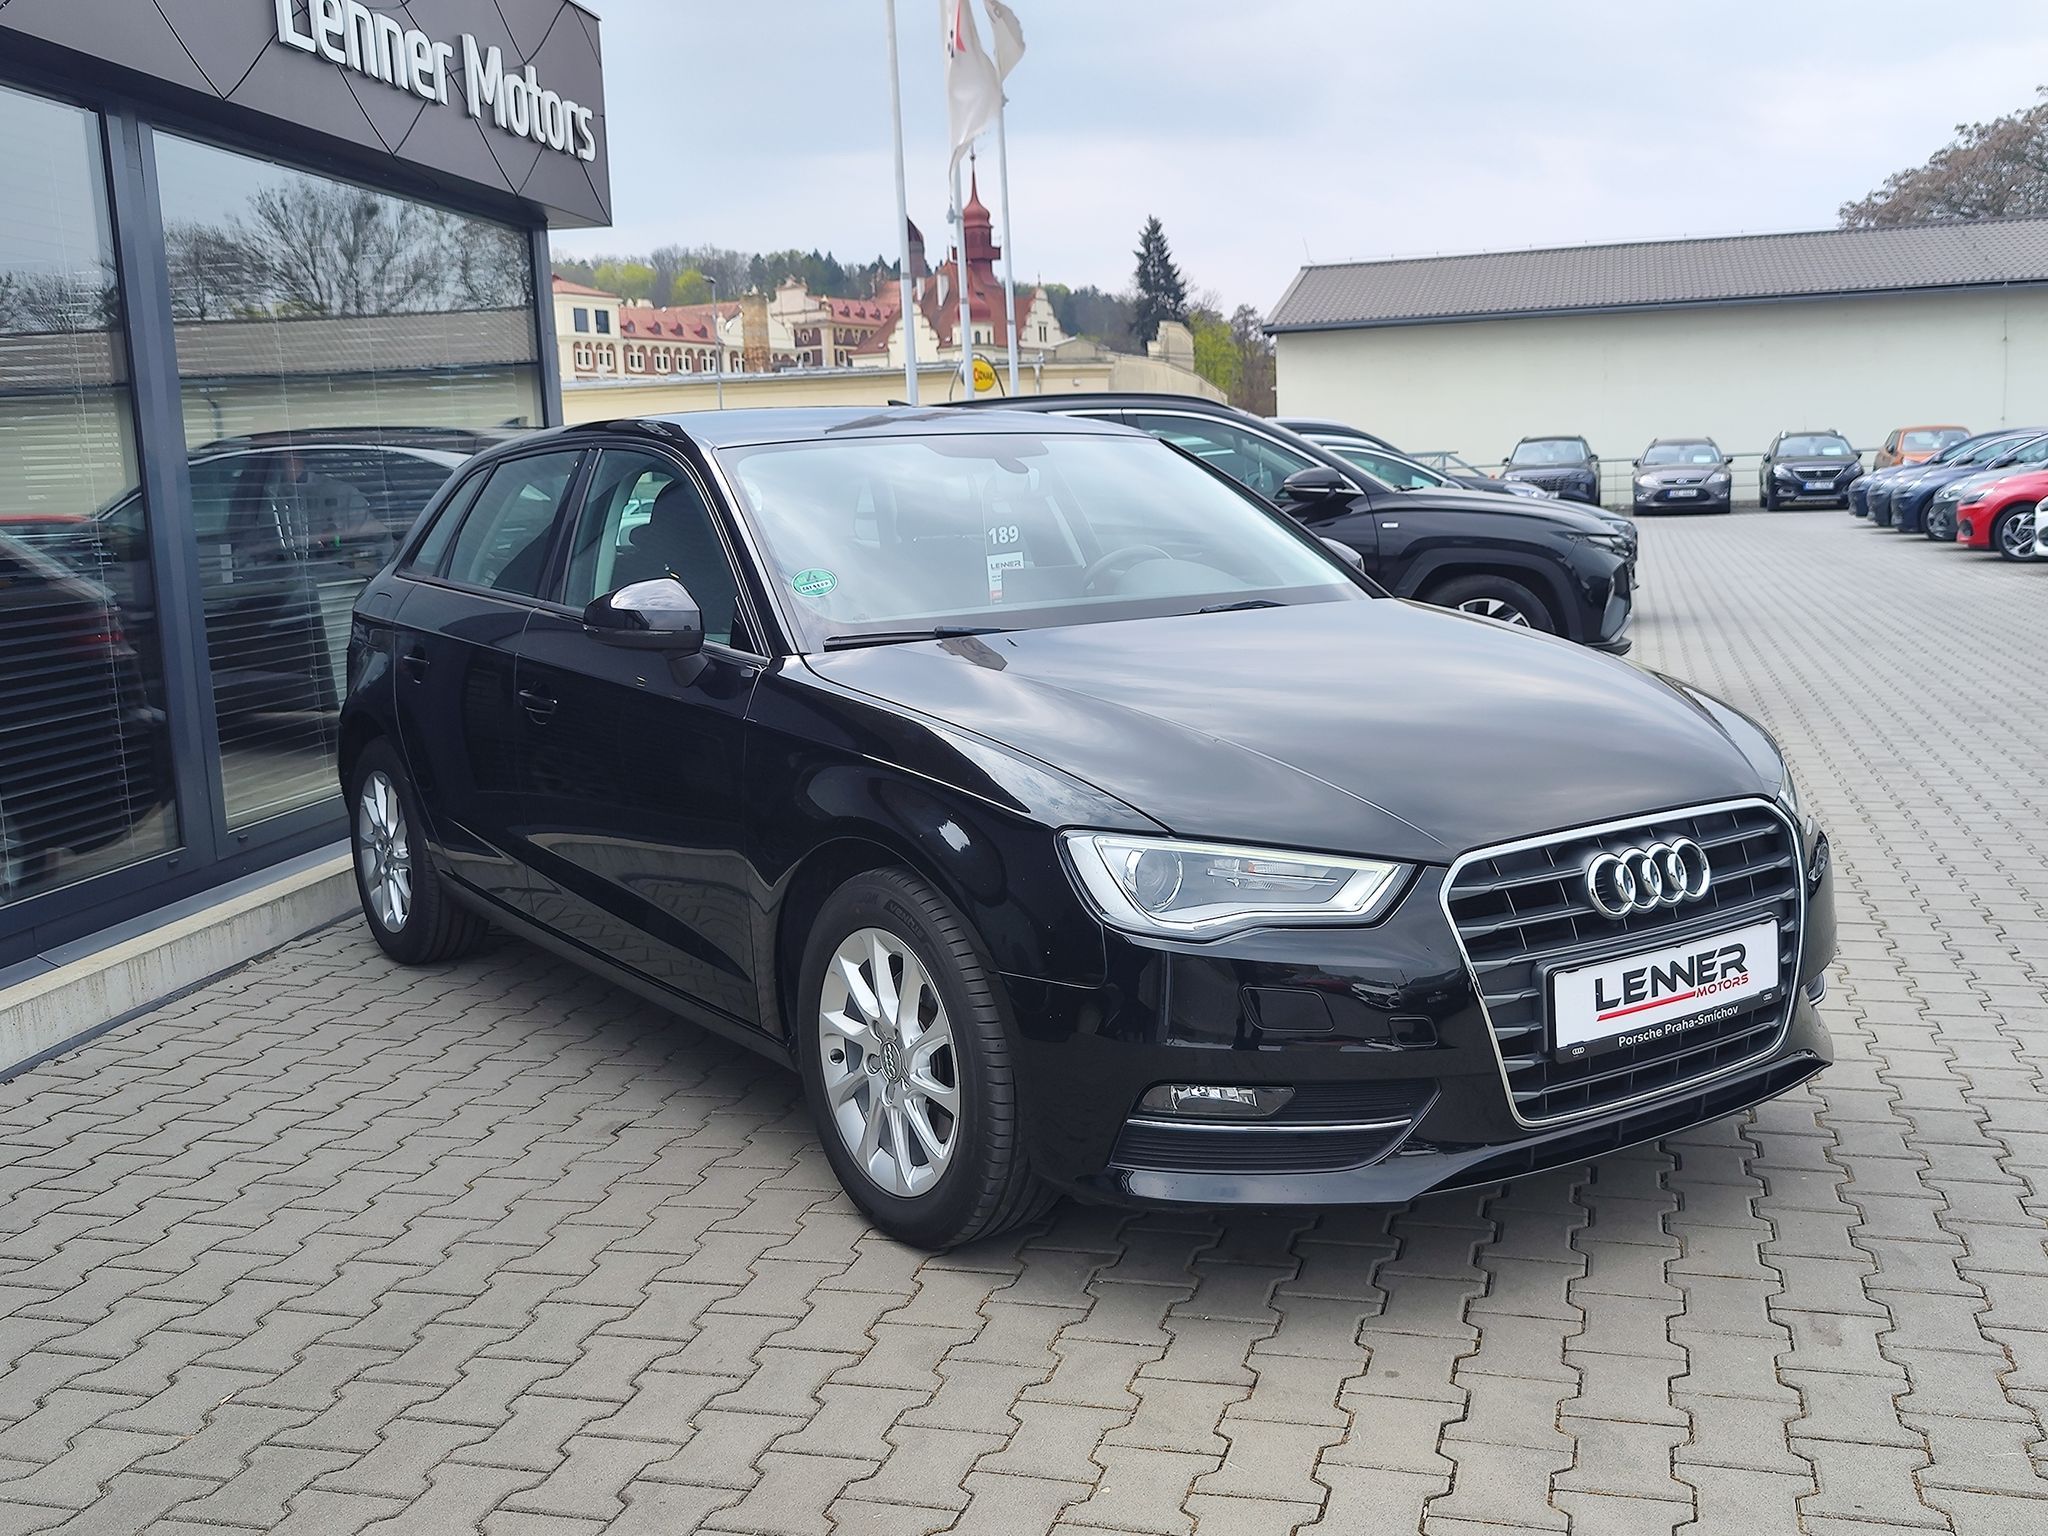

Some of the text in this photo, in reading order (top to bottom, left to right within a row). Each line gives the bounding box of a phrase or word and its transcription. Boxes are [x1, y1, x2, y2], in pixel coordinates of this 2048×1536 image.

[275, 0, 597, 163] Lenner Motors
[988, 525, 1019, 545] 189
[1595, 943, 1748, 1012] LENNER
[1696, 973, 1749, 998] MOTORS
[1618, 1004, 1739, 1047] Porsche Praha-Smíchov
